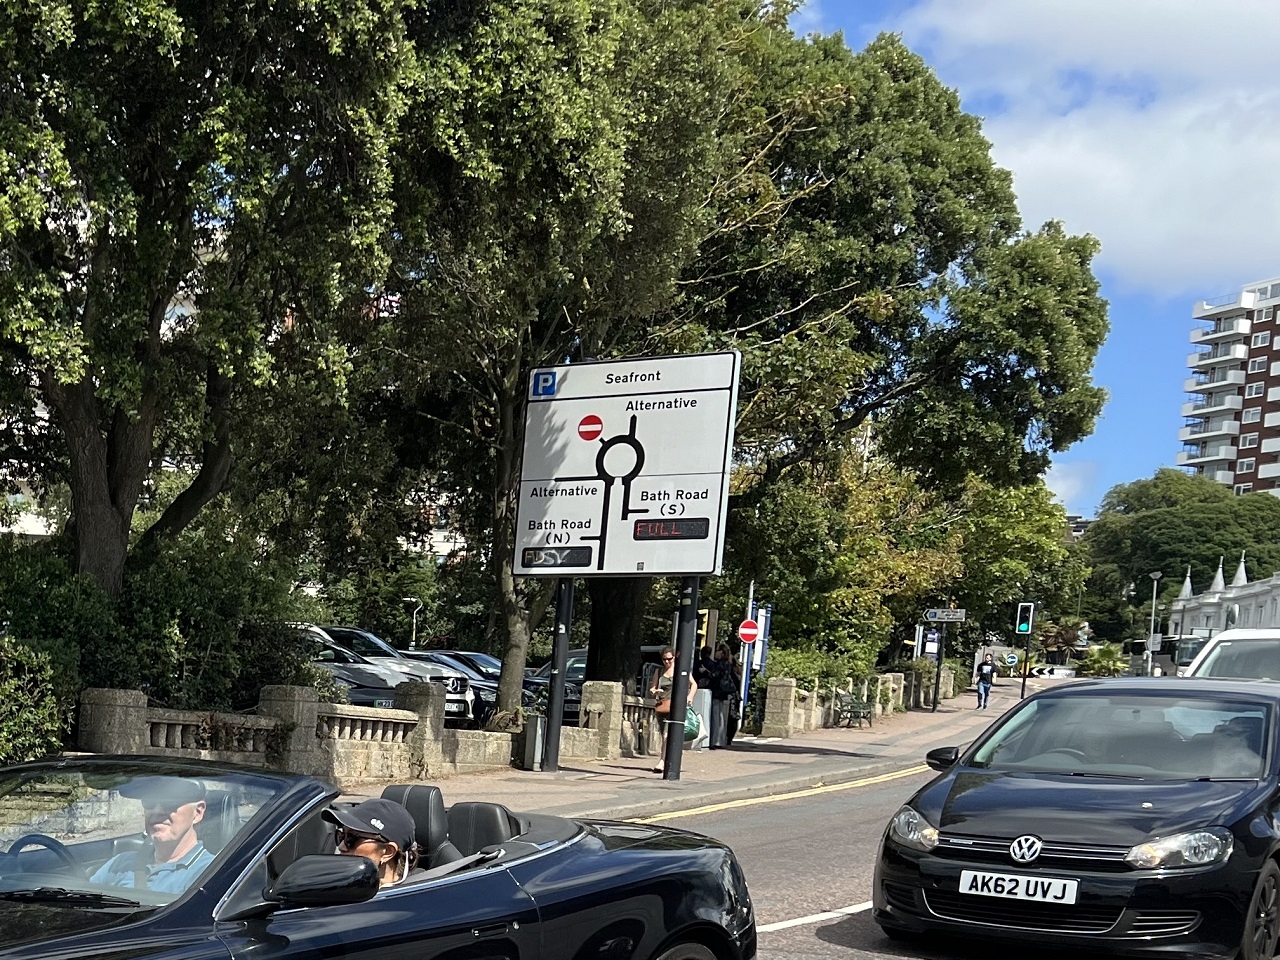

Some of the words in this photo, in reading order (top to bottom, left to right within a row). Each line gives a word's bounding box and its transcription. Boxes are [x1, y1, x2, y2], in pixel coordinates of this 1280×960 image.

[605, 370, 661, 384] Seafront
[625, 397, 698, 411] Alternative
[530, 485, 598, 498] Alternative
[641, 490, 670, 501] Bath
[675, 488, 709, 500] Road
[660, 503, 685, 516] (S)
[528, 519, 556, 531] Bath
[561, 518, 591, 530] Road
[636, 521, 682, 537] FULL
[545, 532, 571, 545] (N)
[969, 874, 1020, 896] AK62
[1025, 879, 1067, 900] UVJ
